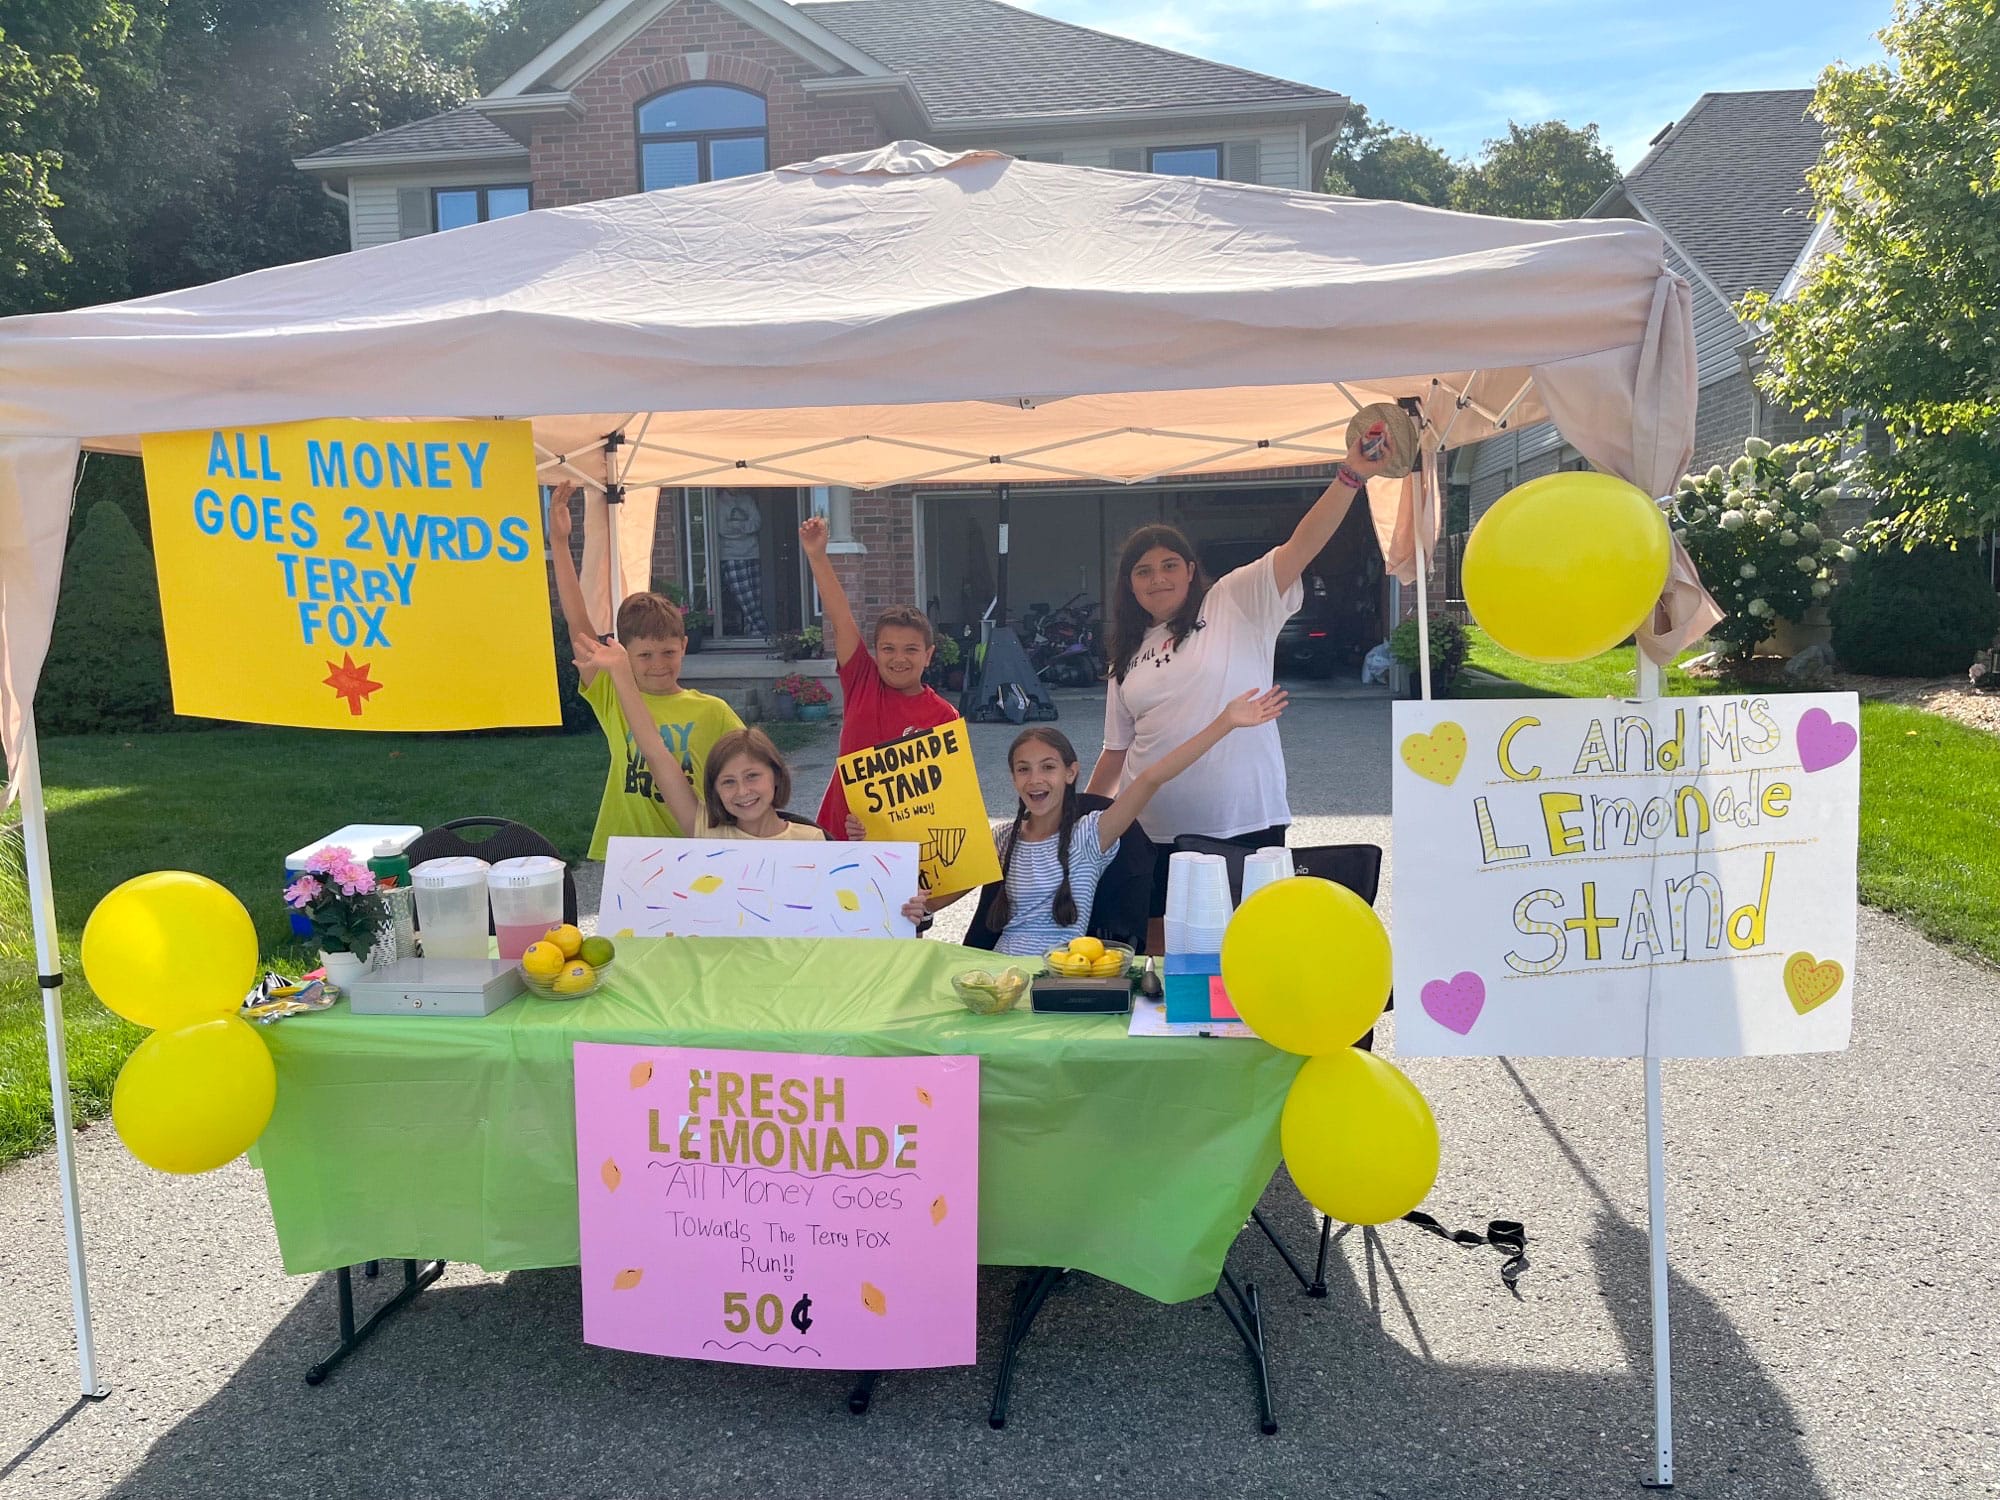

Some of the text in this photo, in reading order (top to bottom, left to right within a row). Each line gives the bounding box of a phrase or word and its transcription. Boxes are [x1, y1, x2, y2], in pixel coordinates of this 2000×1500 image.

[207, 431, 490, 489] ALL MONEY
[194, 488, 530, 562] GOES 2WRDS
[277, 553, 416, 606] TERRY
[299, 602, 391, 648] FOX
[840, 730, 959, 786] LEMONADE
[1497, 715, 1542, 782] C
[864, 765, 943, 813] STAND
[688, 1069, 845, 1125] FRESH
[648, 1108, 918, 1172] LEMONADE
[666, 1166, 705, 1200] All
[722, 1168, 815, 1207] Money
[741, 1246, 795, 1274] Run!!
[763, 1221, 796, 1243] The
[806, 1224, 848, 1247] Terry
